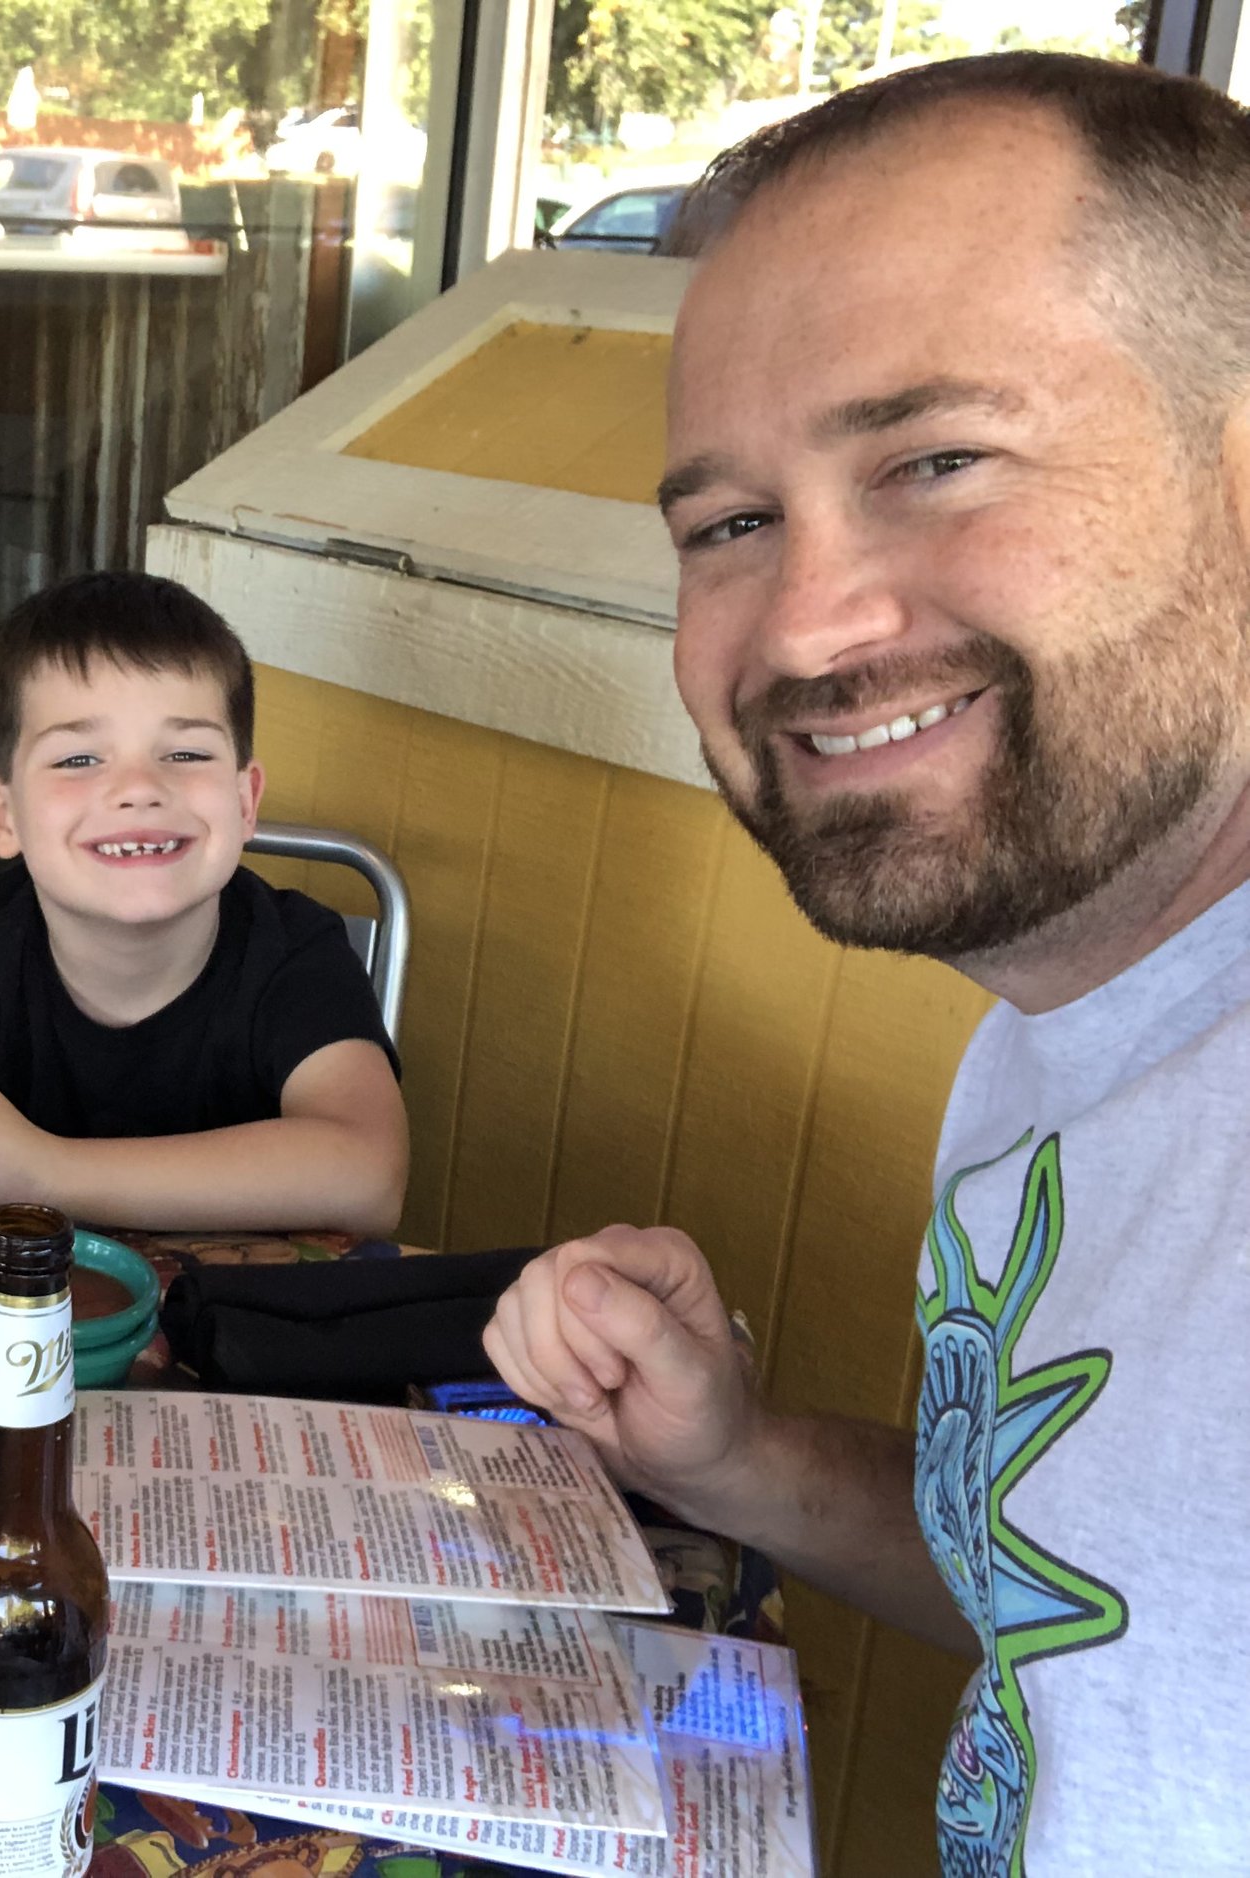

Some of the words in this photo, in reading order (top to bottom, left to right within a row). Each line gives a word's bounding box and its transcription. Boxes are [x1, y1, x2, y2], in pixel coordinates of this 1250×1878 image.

[55, 1700, 96, 1784] Li
[143, 1714, 157, 1738] Skins
[141, 1742, 156, 1771] Papa
[227, 1710, 243, 1779] Chimichangas
[313, 1728, 326, 1787] Quesadillas
[399, 1723, 412, 1766] Calamari
[400, 1769, 413, 1796] Fried
[462, 1766, 478, 1802] Angels
[553, 1827, 566, 1859] Fried
